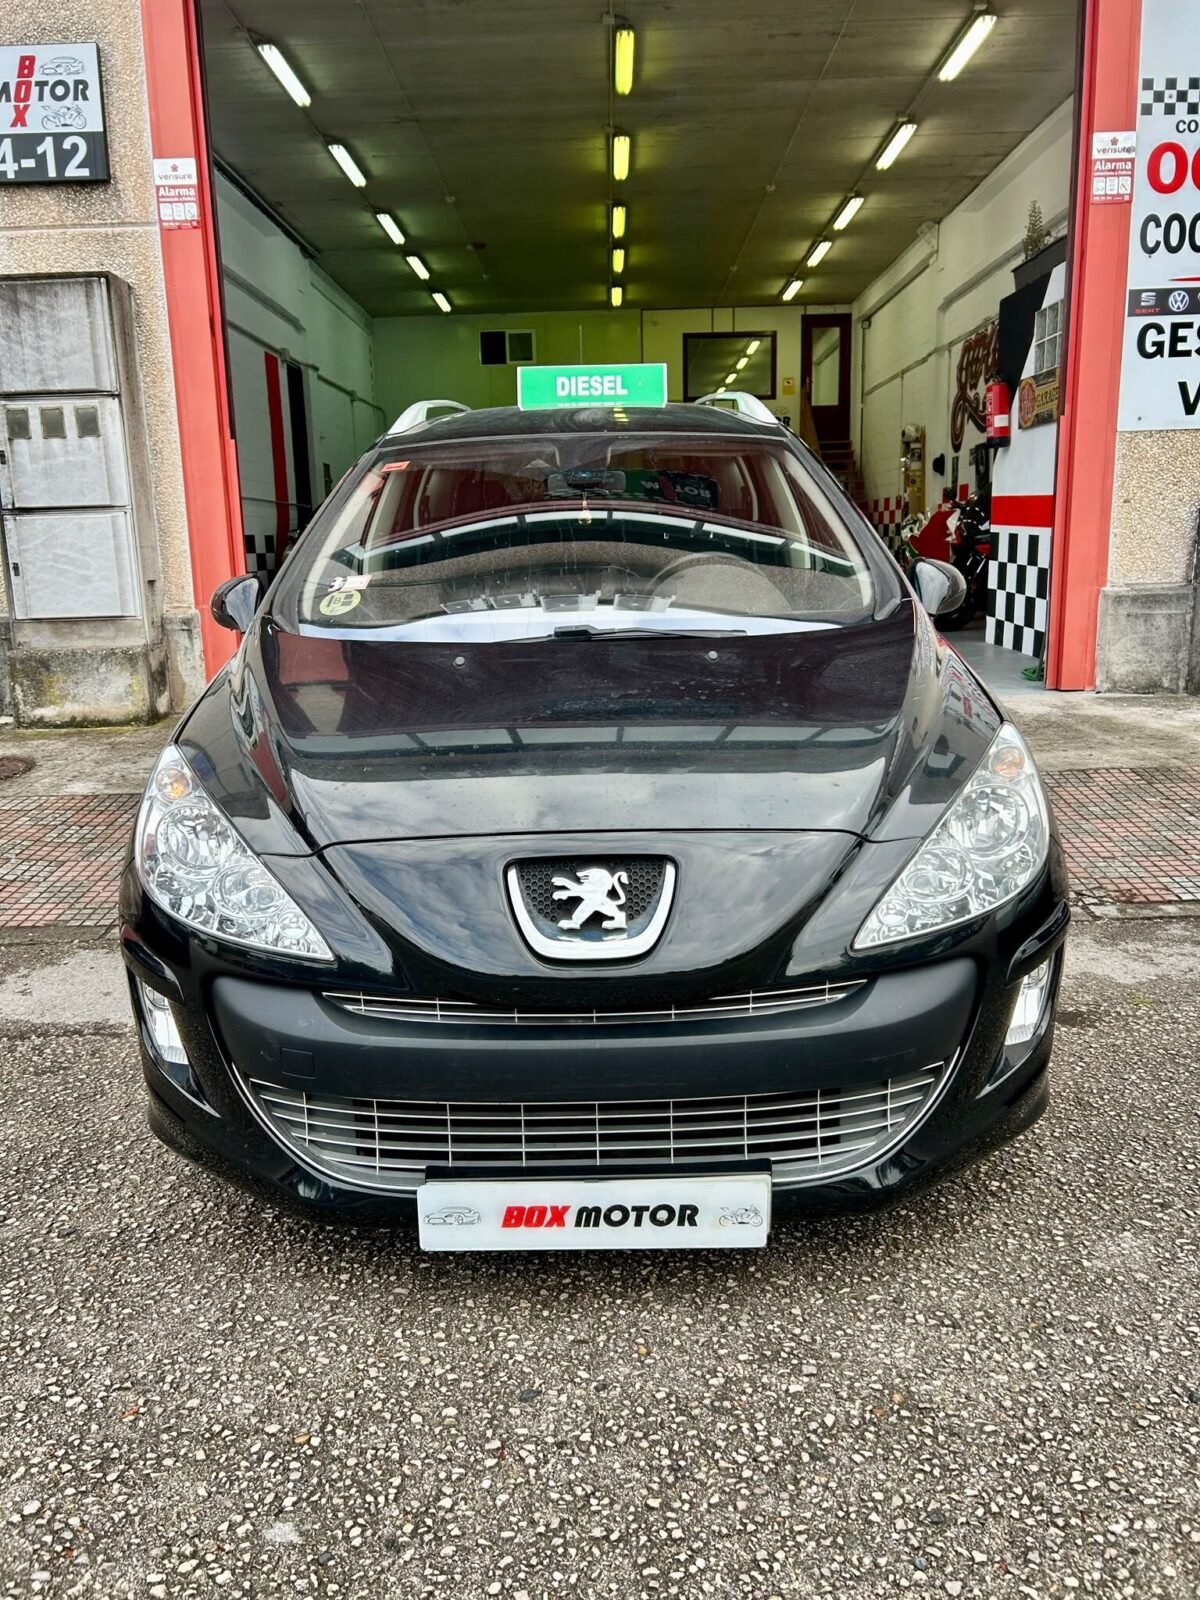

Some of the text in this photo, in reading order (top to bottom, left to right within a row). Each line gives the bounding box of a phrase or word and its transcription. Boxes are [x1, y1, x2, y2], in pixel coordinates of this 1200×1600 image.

[1094, 160, 1132, 171] Alarma
[1147, 142, 1200, 194] O
[158, 173, 193, 181] verisure
[158, 186, 196, 197] Alarma
[1137, 321, 1200, 360] GE
[556, 375, 628, 397] DIESEL
[501, 1204, 698, 1228] BOX MOTOR
